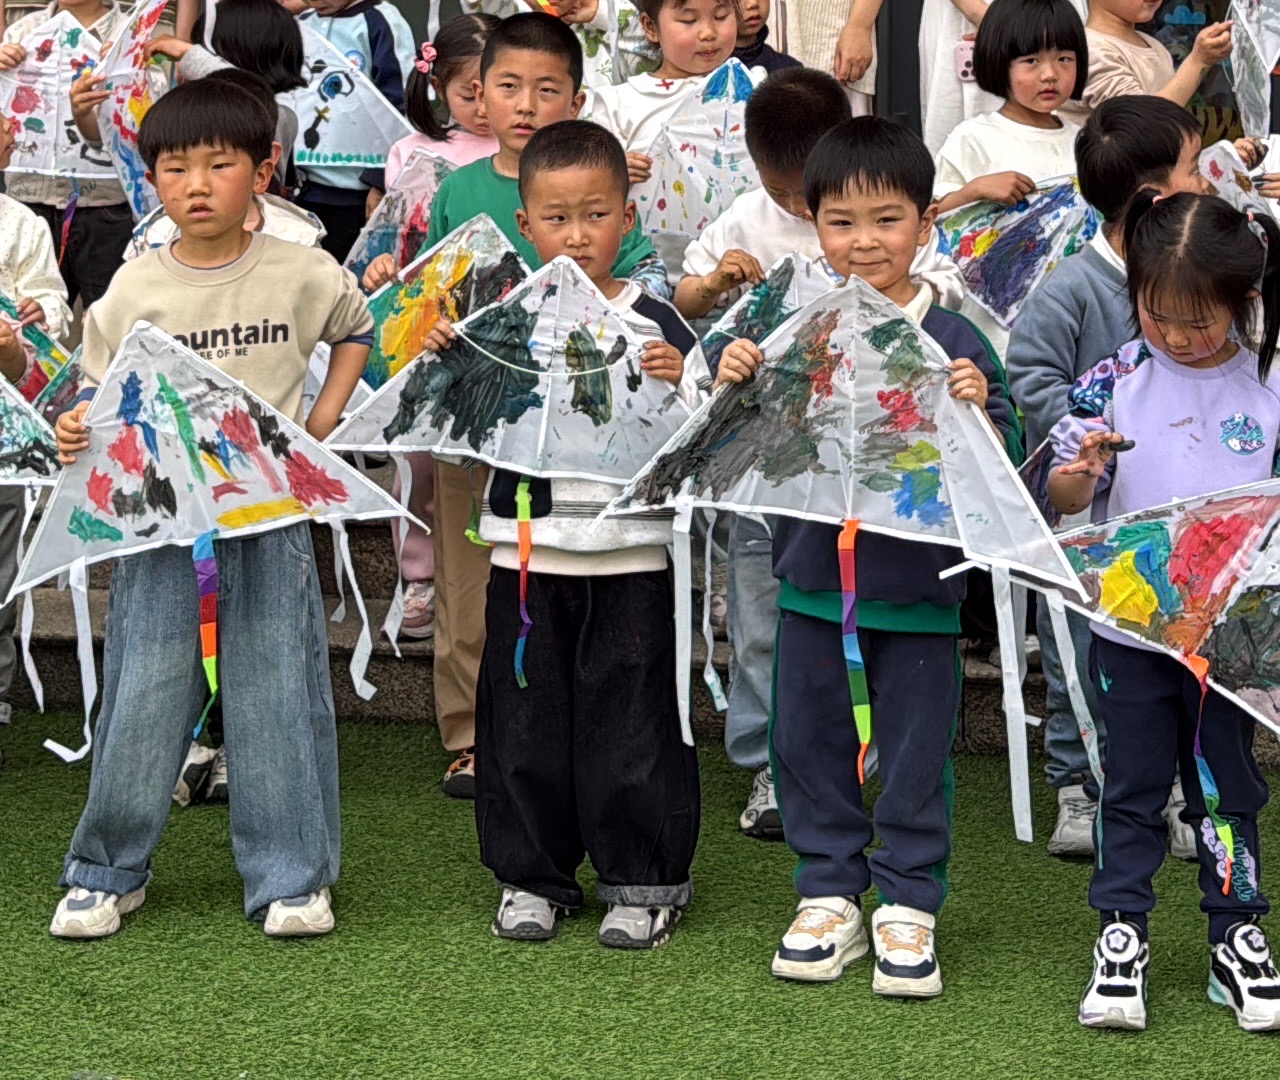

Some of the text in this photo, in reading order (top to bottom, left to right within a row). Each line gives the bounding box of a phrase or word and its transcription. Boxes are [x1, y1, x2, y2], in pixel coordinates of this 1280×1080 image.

[172, 319, 289, 350] ountain
[217, 349, 230, 358] OF
[235, 347, 248, 356] ME
